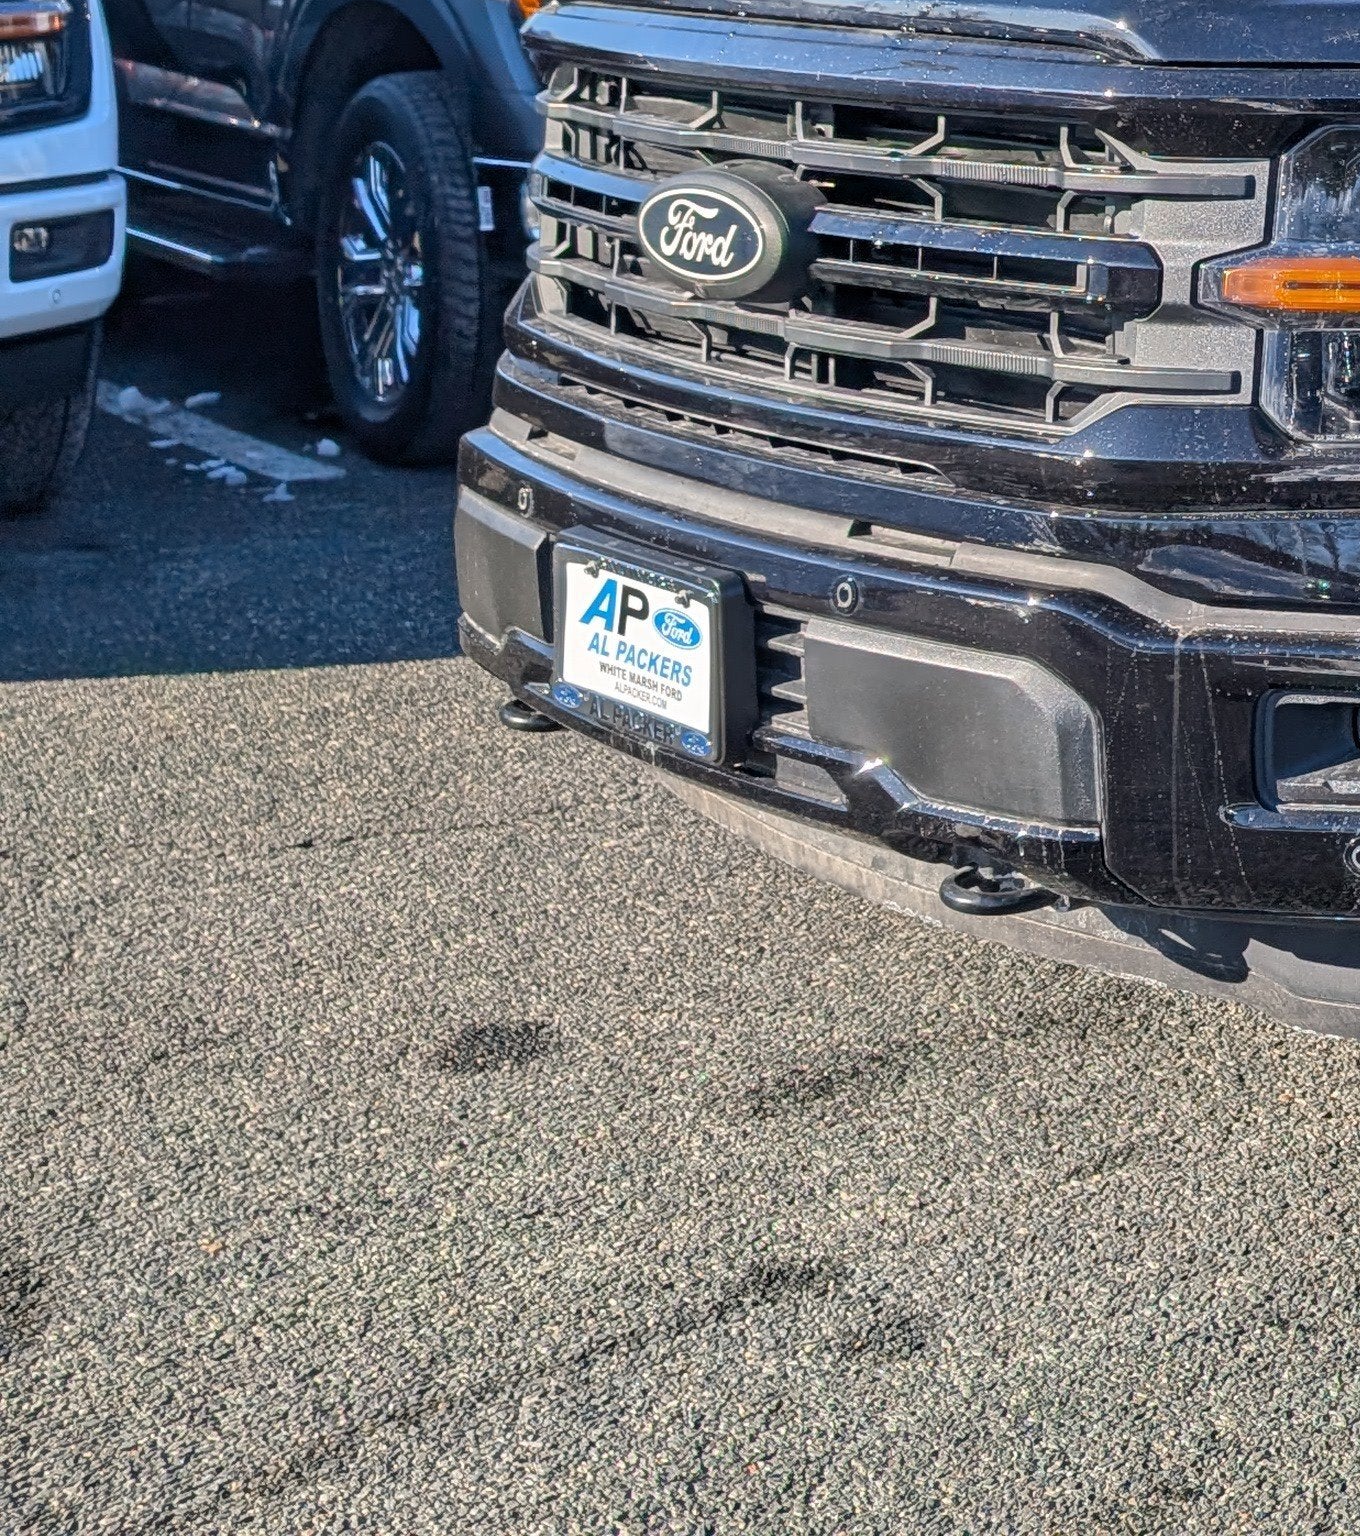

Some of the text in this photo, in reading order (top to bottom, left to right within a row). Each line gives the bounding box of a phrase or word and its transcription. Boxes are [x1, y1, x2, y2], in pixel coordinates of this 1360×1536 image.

[660, 198, 738, 268] Ford
[579, 578, 649, 636] AP
[661, 612, 694, 644] Ford
[587, 632, 693, 687] AL PACKERS
[599, 660, 683, 702] WHITE MARSH FORD
[614, 681, 668, 710] ALPACKER.COM
[589, 694, 611, 720] AL
